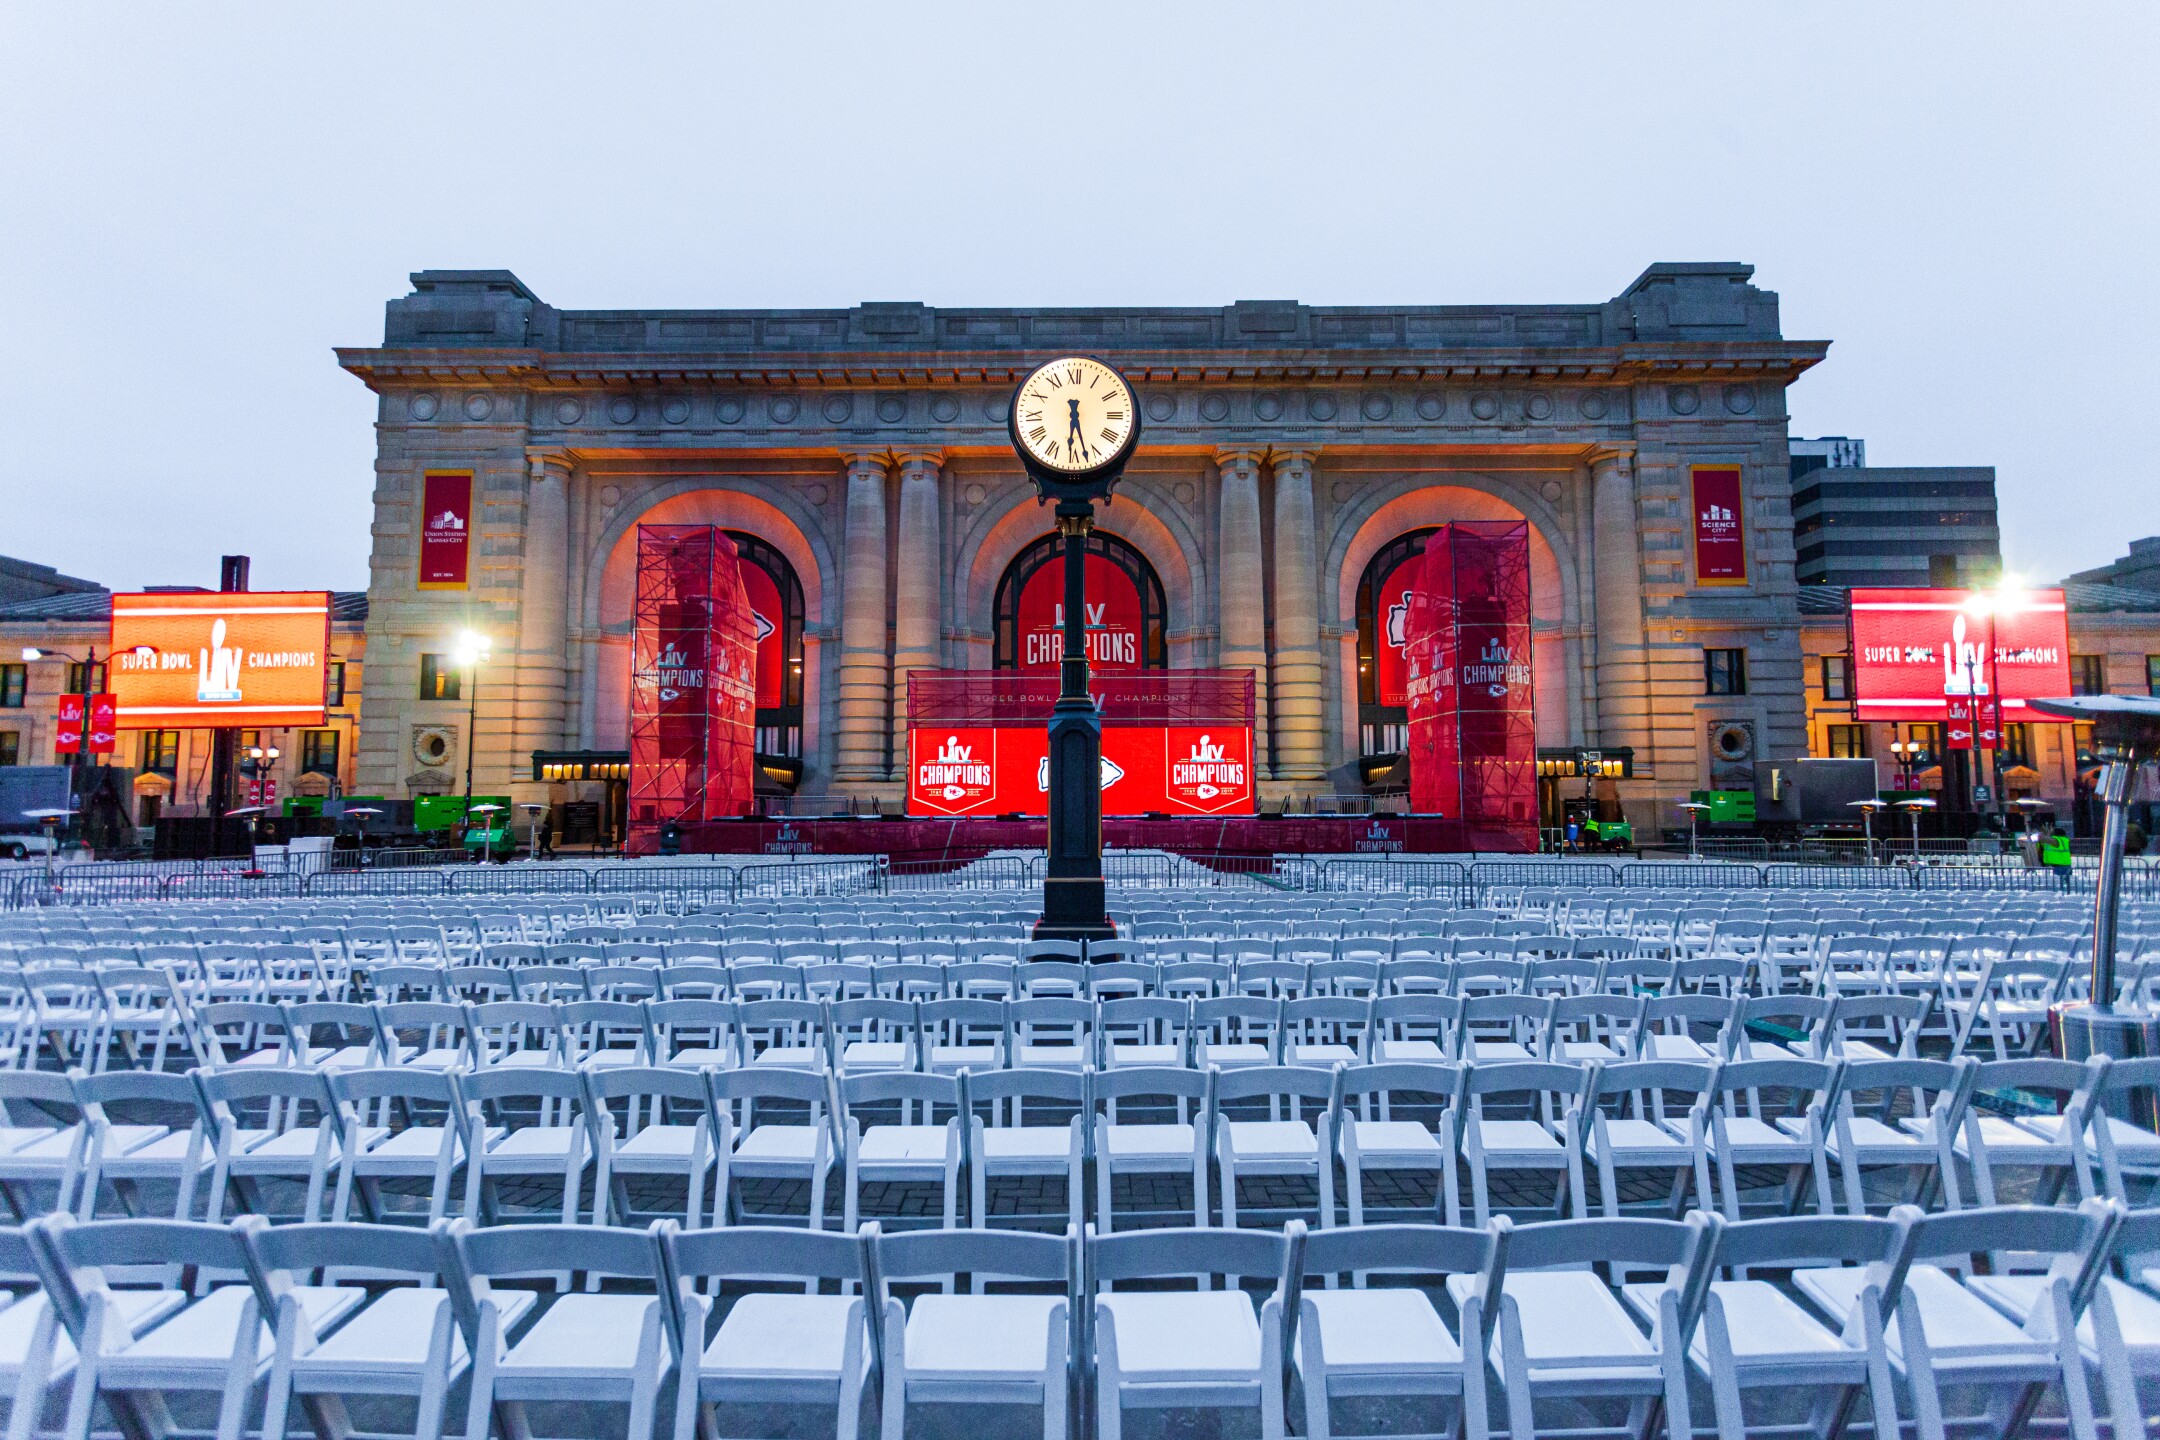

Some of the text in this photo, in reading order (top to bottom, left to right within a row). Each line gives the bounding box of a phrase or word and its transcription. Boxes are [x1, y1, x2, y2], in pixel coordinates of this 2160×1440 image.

[1067, 369, 1081, 384] XII
[1107, 411, 1123, 419] III
[1055, 604, 1105, 625] LV
[1027, 633, 1135, 664] CHAPIONS
[1865, 647, 1900, 663] SUPER
[122, 652, 157, 669] SUPER
[162, 653, 193, 669] BOWL
[249, 652, 315, 667] CHAMPIONS
[639, 669, 704, 688] CHAMPIONS
[1464, 665, 1530, 684] CHAMPIONS
[1020, 694, 1052, 702] BOWL
[1115, 694, 1186, 702] CHAMPIONS
[920, 765, 990, 786] CHAMPIONS
[1173, 764, 1244, 785] CHAMPIONS
[765, 842, 812, 853] CHAMPIONS
[1356, 840, 1403, 852] CHAMPIONS
